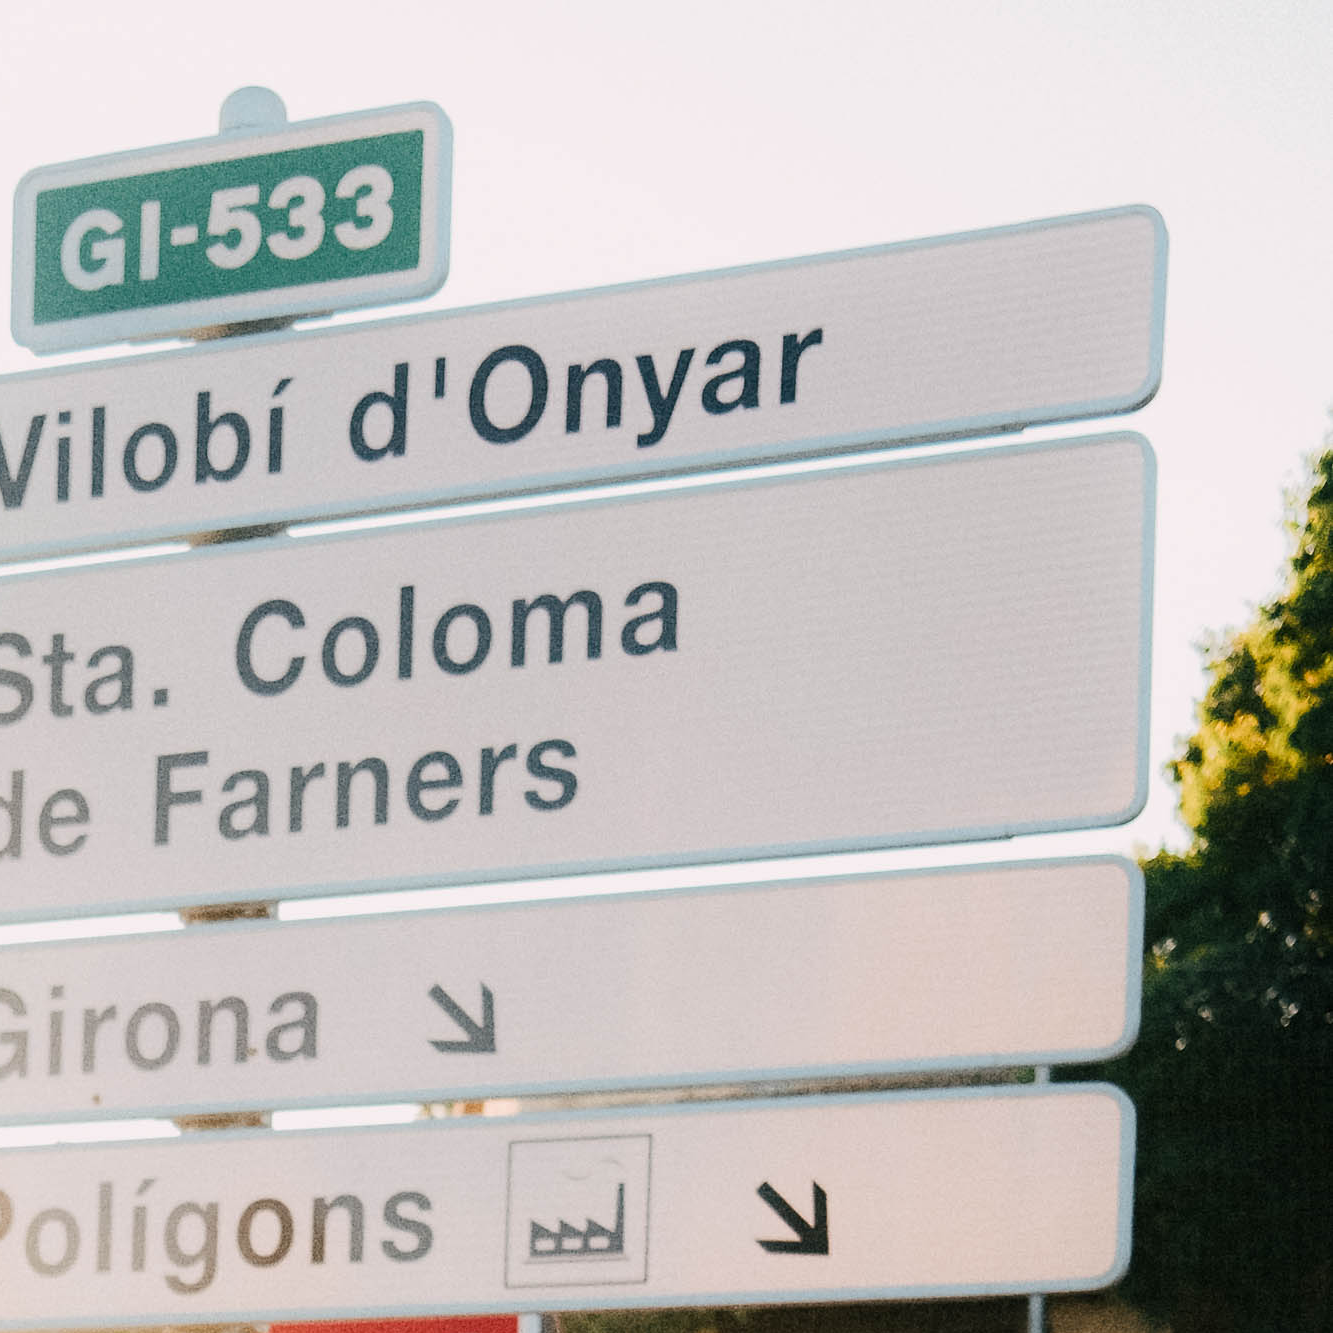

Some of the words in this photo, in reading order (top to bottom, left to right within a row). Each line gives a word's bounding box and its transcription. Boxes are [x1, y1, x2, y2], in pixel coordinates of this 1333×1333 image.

[59, 162, 396, 294] GI-533
[345, 325, 827, 466] d'Onyar
[232, 577, 682, 699] Coloma
[151, 736, 581, 850] Farners
